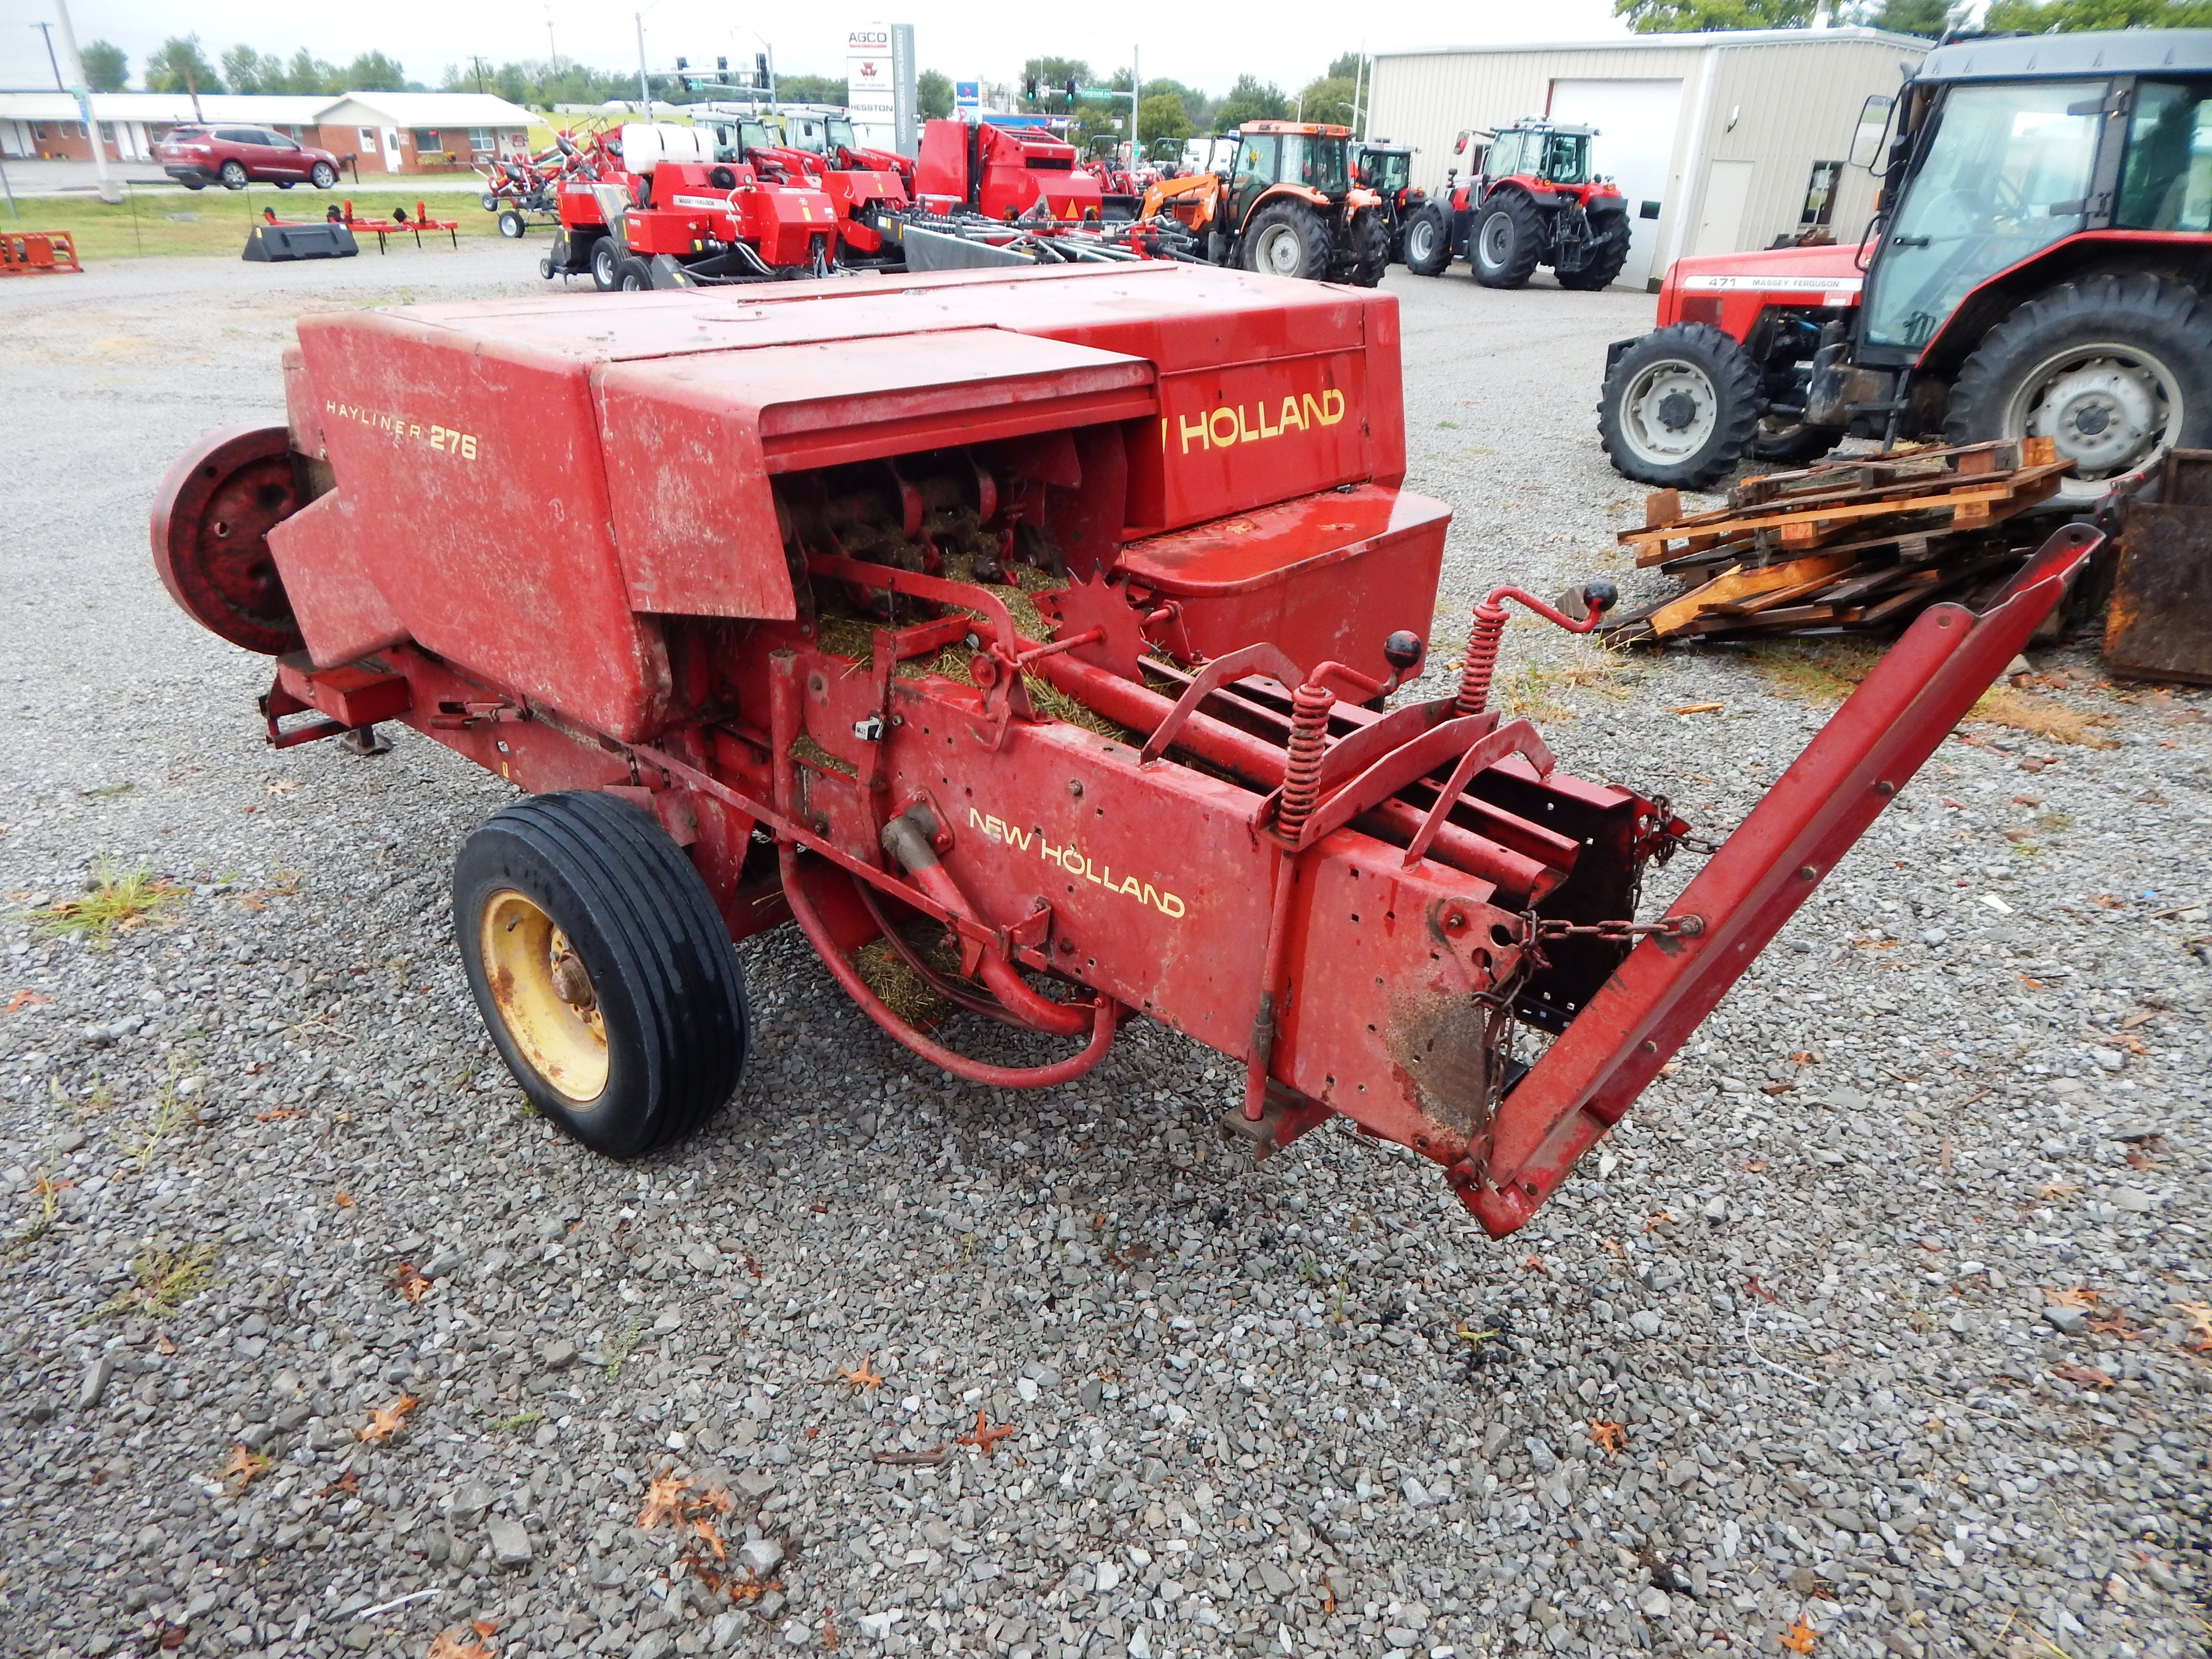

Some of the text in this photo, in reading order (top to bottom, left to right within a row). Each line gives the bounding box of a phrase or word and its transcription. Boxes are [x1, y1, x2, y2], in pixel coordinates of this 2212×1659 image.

[849, 32, 887, 43] AGCO
[897, 28, 905, 82] IMPLEMENT
[851, 104, 893, 112] HESSTON
[1709, 278, 1736, 287] 471
[327, 400, 477, 460] HAYLINER 276
[1179, 388, 1345, 455] HOLLAND
[970, 807, 1185, 918] NEW HOLLAND
